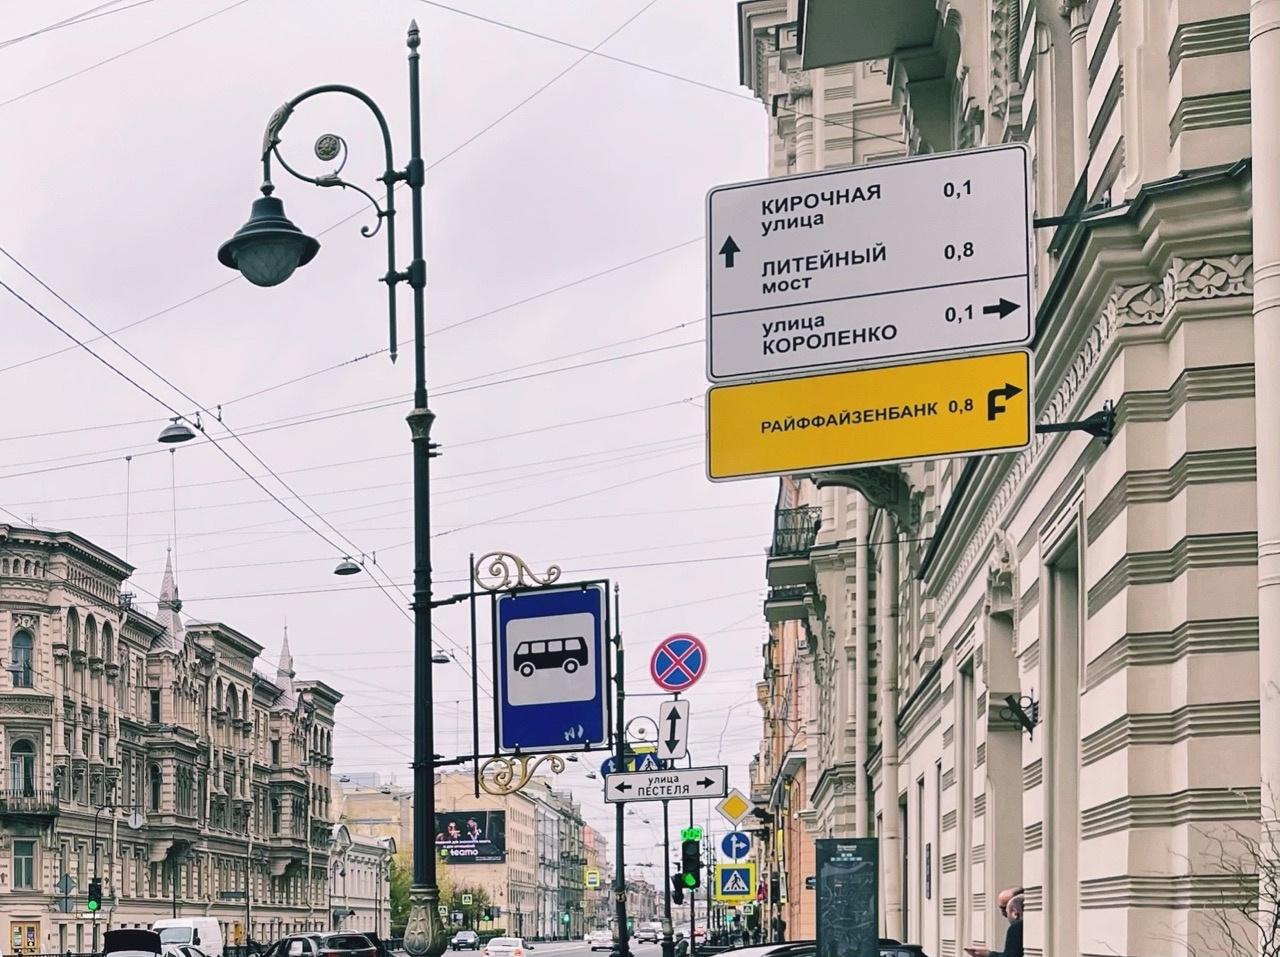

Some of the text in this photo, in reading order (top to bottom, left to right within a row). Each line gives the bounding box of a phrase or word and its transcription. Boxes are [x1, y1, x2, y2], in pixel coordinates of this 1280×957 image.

[761, 179, 972, 215] КИРОЧНАЯ 0,1
[761, 213, 824, 236] улица
[761, 241, 975, 277] ЛИТЕЙНЫЙ 0,8
[762, 276, 813, 294] мост
[762, 304, 974, 338] улица 0,1
[762, 324, 898, 355] КОРОЛЕНКО
[761, 398, 974, 434] РАЙФФАЙЗЕНБАНК 0,8
[638, 785, 690, 796] ПЕСТЕЛЯ
[648, 775, 680, 786] улица
